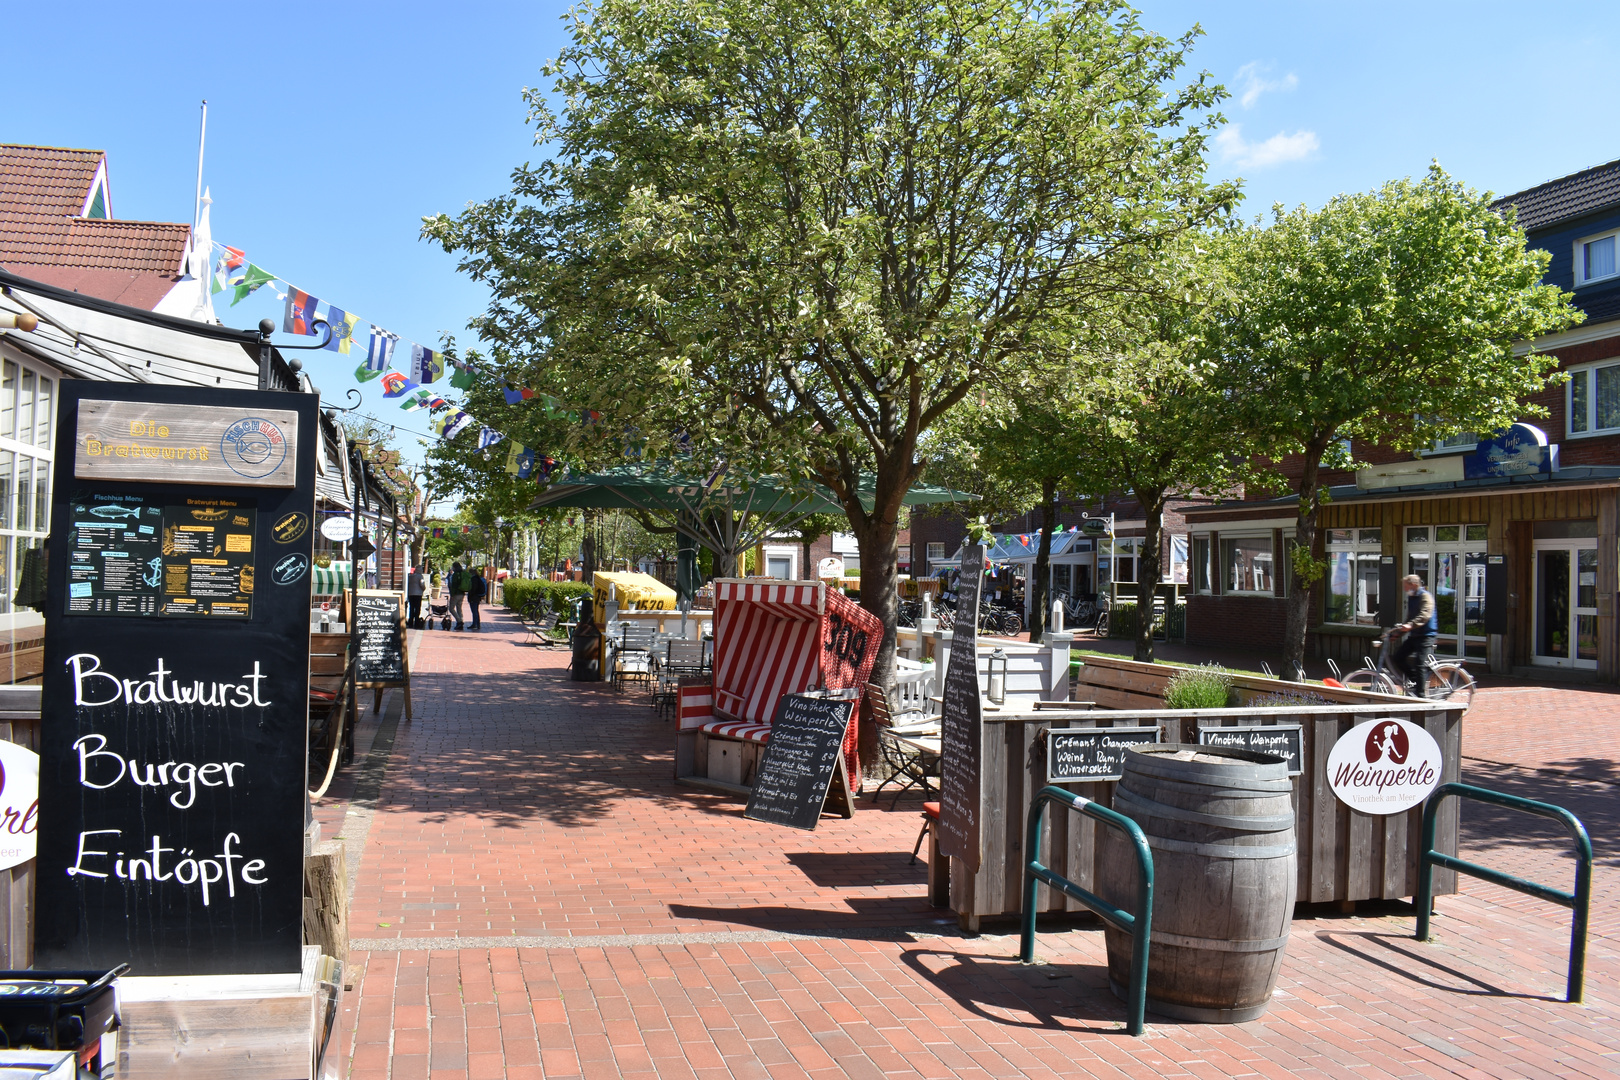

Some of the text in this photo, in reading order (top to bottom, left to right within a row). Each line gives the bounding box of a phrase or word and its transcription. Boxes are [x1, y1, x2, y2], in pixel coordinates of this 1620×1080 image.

[130, 420, 169, 437] Die
[86, 439, 210, 461] Bratwurst
[1505, 433, 1520, 450] Info
[1501, 461, 1529, 471] TICKETS
[186, 498, 219, 506] Bratwurst
[274, 514, 298, 532] Bratwurst
[825, 613, 867, 668] 309
[65, 653, 272, 708] Bratwurst
[789, 698, 831, 713] Vinothek
[784, 709, 837, 728] Weinperle
[774, 730, 802, 743] Crémant
[1207, 733, 1289, 748] Vinothek Weinperle
[1280, 749, 1296, 760] Uhr
[73, 733, 245, 809] Burger
[1334, 760, 1435, 794] Weinperle
[1352, 794, 1384, 803] Vinothek
[1398, 793, 1417, 801] Meer
[0, 848, 21, 857] eer
[66, 829, 269, 906] Eintöpfe
